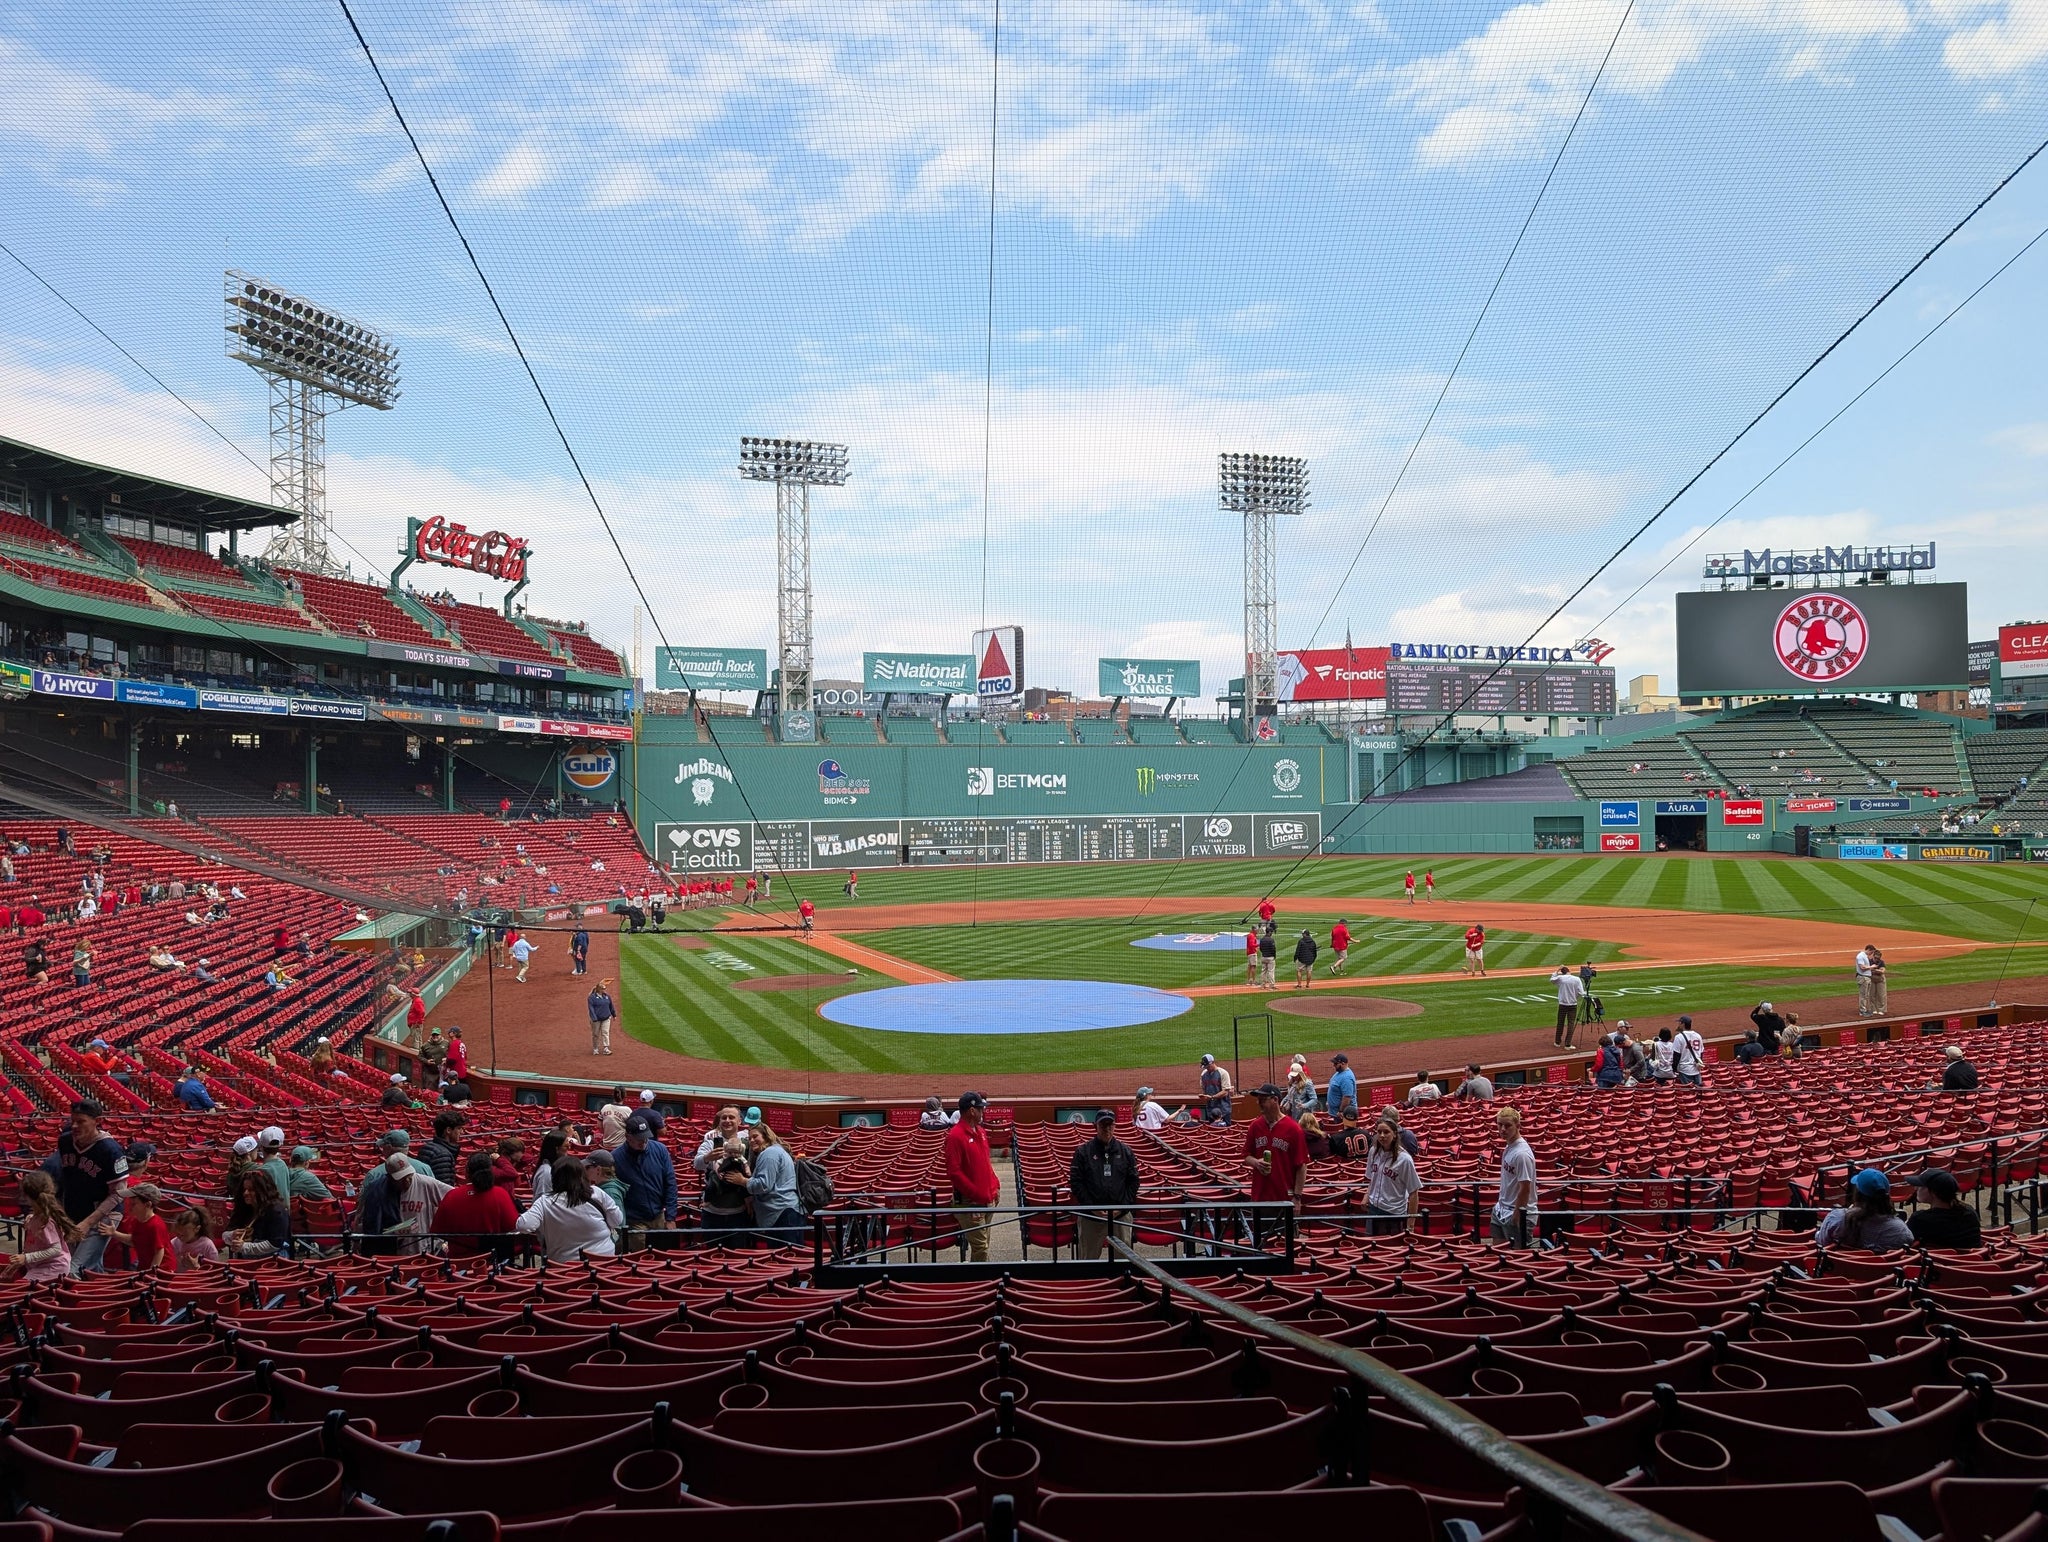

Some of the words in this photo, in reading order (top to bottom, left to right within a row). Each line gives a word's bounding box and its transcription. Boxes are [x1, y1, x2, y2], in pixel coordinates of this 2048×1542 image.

[1743, 541, 1936, 574] MassMutual
[1786, 600, 1856, 627] BOSTON
[404, 650, 434, 663] TODAY'S
[436, 654, 470, 667] STARTERS
[1390, 643, 1448, 659] BANK
[1454, 644, 1479, 659] OF
[1485, 646, 1574, 662] AMERICA
[667, 658, 723, 673] Plymouth
[725, 659, 756, 673] Rock
[1785, 648, 1818, 675] RED
[1827, 647, 1858, 674] SOX
[523, 666, 552, 678] UNITED
[894, 661, 966, 679] National
[920, 679, 934, 687] Car
[937, 679, 964, 688] Rental
[978, 677, 1012, 694] CITGO
[1122, 673, 1175, 686] DRAFT
[59, 679, 96, 694] HYCU
[1129, 684, 1173, 695] KINGS
[202, 693, 239, 703] COGHLIN
[239, 696, 287, 707] COMPANIES
[299, 703, 339, 713] VINEYARD
[339, 706, 363, 716] VINES
[382, 710, 412, 720] MARTINEZ
[434, 714, 443, 722] VS
[1360, 741, 1397, 749] ABIOMED
[564, 757, 611, 772] Gulf
[698, 757, 734, 785] BEAM
[848, 779, 870, 787] SOX
[997, 774, 1066, 788] BETMGM
[1156, 773, 1199, 781] MONSTER
[1602, 807, 1616, 815] city
[1725, 807, 1763, 815] Safelite
[1806, 801, 1834, 810] TICKET
[1203, 818, 1232, 837] 160
[1274, 822, 1304, 835] ACE
[692, 828, 741, 848] CVS
[1274, 833, 1304, 844] TICKET
[1606, 838, 1634, 846] IRVING
[1213, 844, 1246, 855] WEBB
[1843, 846, 1877, 857] jetBlue
[1922, 847, 1965, 858] GRANITE
[671, 849, 742, 869] Health
[1344, 1133, 1369, 1158] 10
[78, 1156, 102, 1178] SOX
[1382, 1167, 1399, 1181] SOX
[1648, 1198, 1669, 1209] 39
